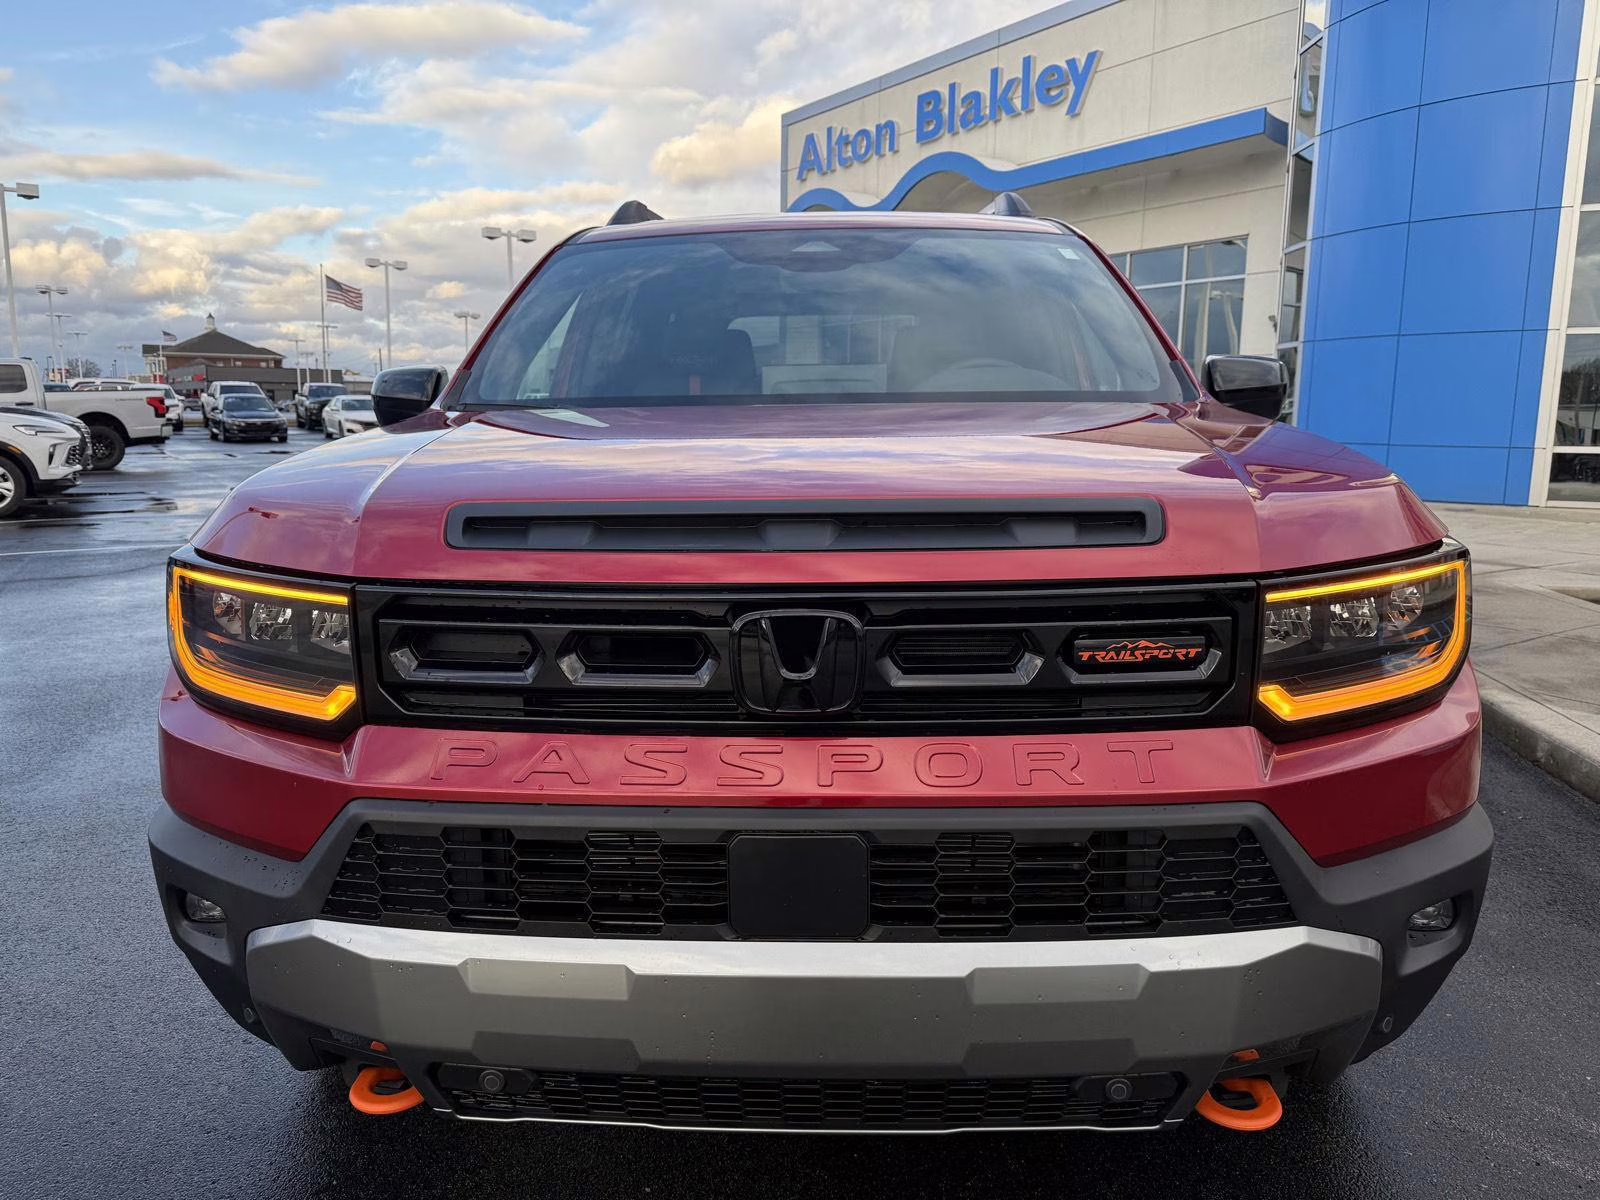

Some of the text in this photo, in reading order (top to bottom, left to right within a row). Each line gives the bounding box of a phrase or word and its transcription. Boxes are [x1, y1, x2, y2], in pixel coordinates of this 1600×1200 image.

[796, 49, 1104, 182] Alton Blakley
[1078, 647, 1203, 663] TRAILSPORT
[430, 738, 1174, 787] PASSPORT
